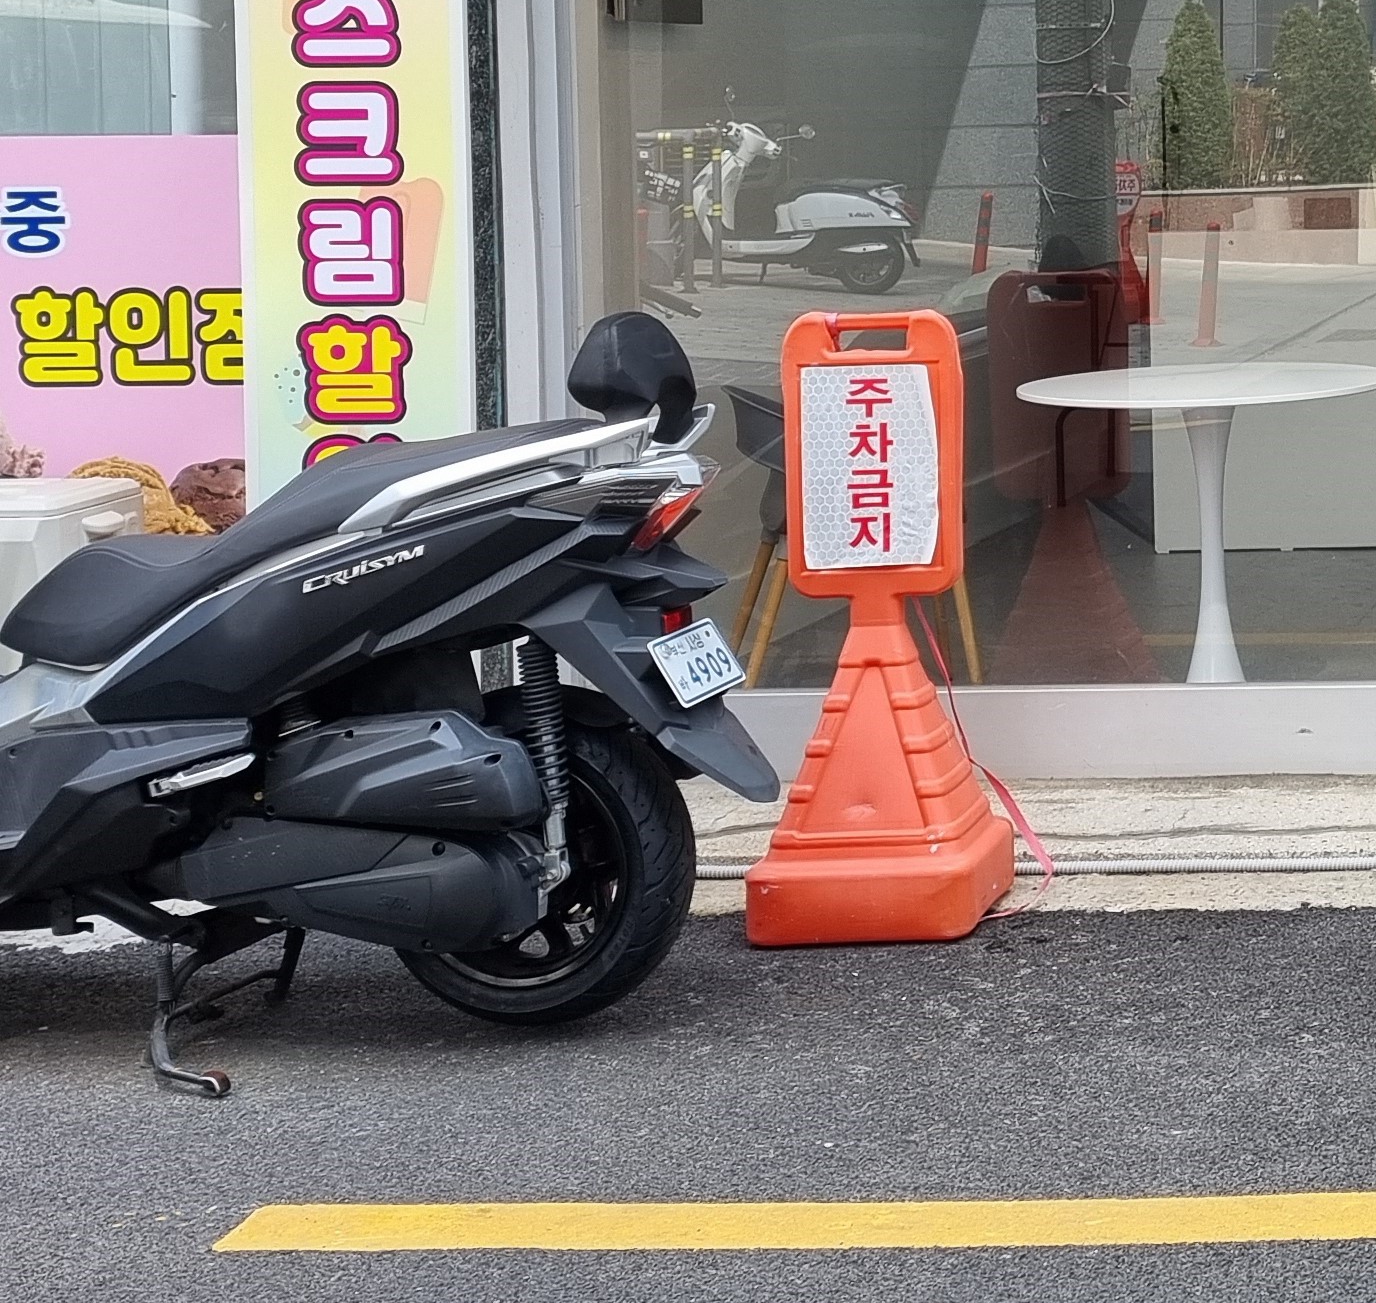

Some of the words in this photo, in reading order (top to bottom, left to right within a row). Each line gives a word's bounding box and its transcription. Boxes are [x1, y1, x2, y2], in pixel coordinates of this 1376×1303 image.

[1, 191, 66, 253] 중
[845, 377, 894, 553] 주차금지
[686, 647, 732, 687] 4909
